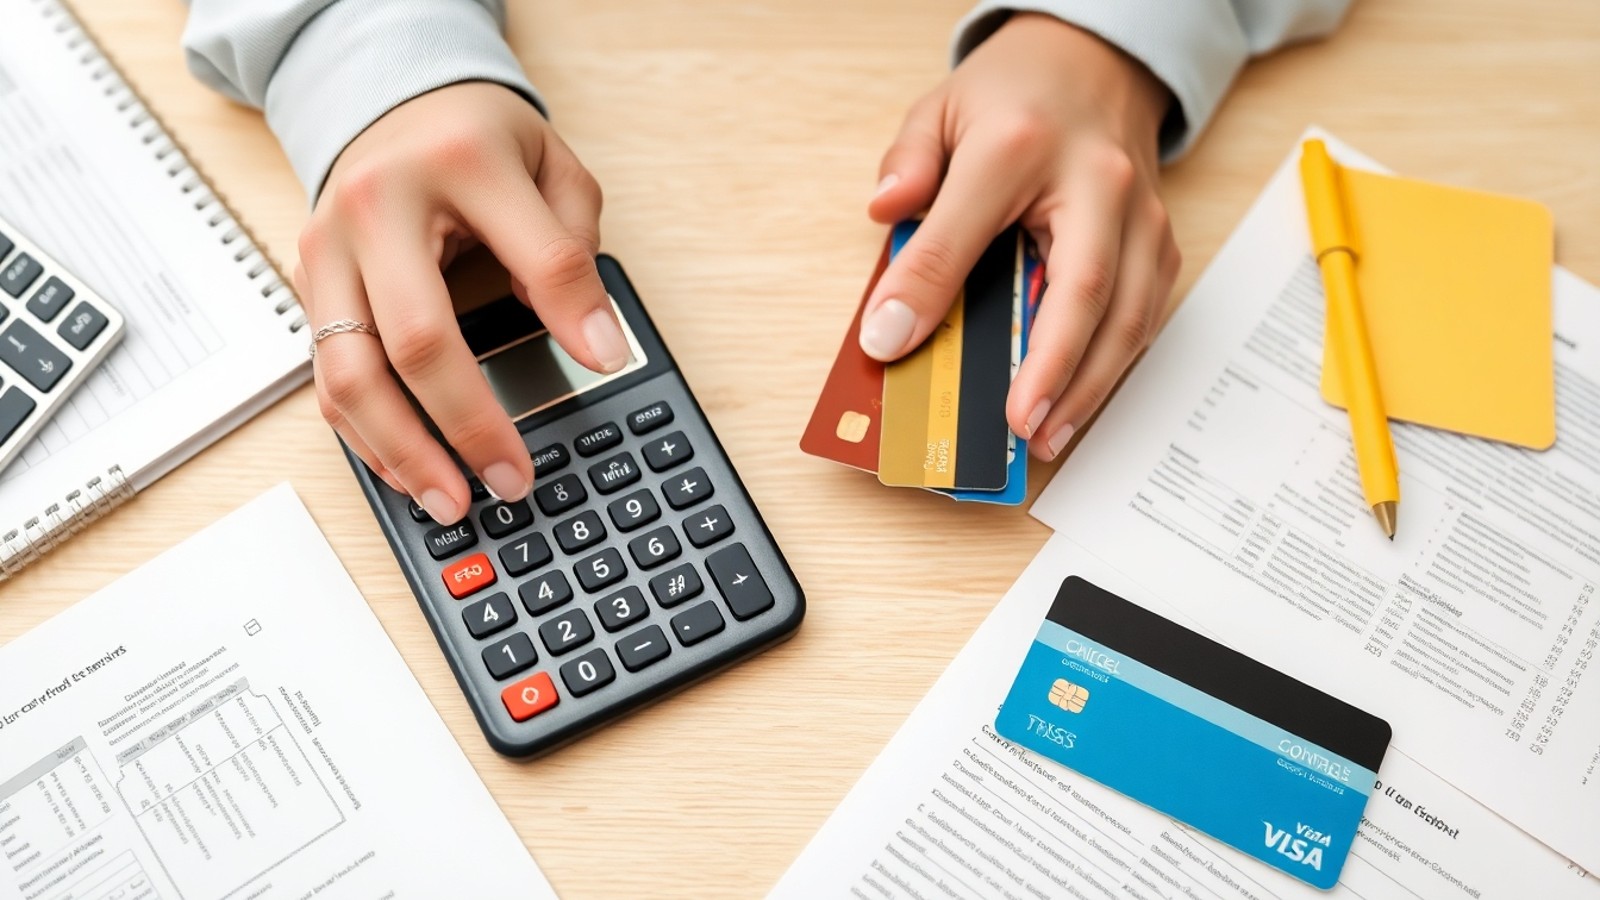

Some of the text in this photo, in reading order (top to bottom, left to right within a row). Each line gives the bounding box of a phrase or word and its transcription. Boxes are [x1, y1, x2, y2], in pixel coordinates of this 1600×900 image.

[625, 498, 643, 519] 9
[572, 520, 590, 541] 8
[514, 542, 529, 563] 7
[647, 536, 665, 557] 6
[591, 557, 610, 579] 5
[537, 580, 555, 600] 4
[482, 603, 500, 623] 4
[611, 596, 631, 619] 3
[557, 619, 577, 643] 2
[501, 643, 517, 664] 1
[577, 660, 598, 682] 0
[1261, 819, 1323, 871] VISA
